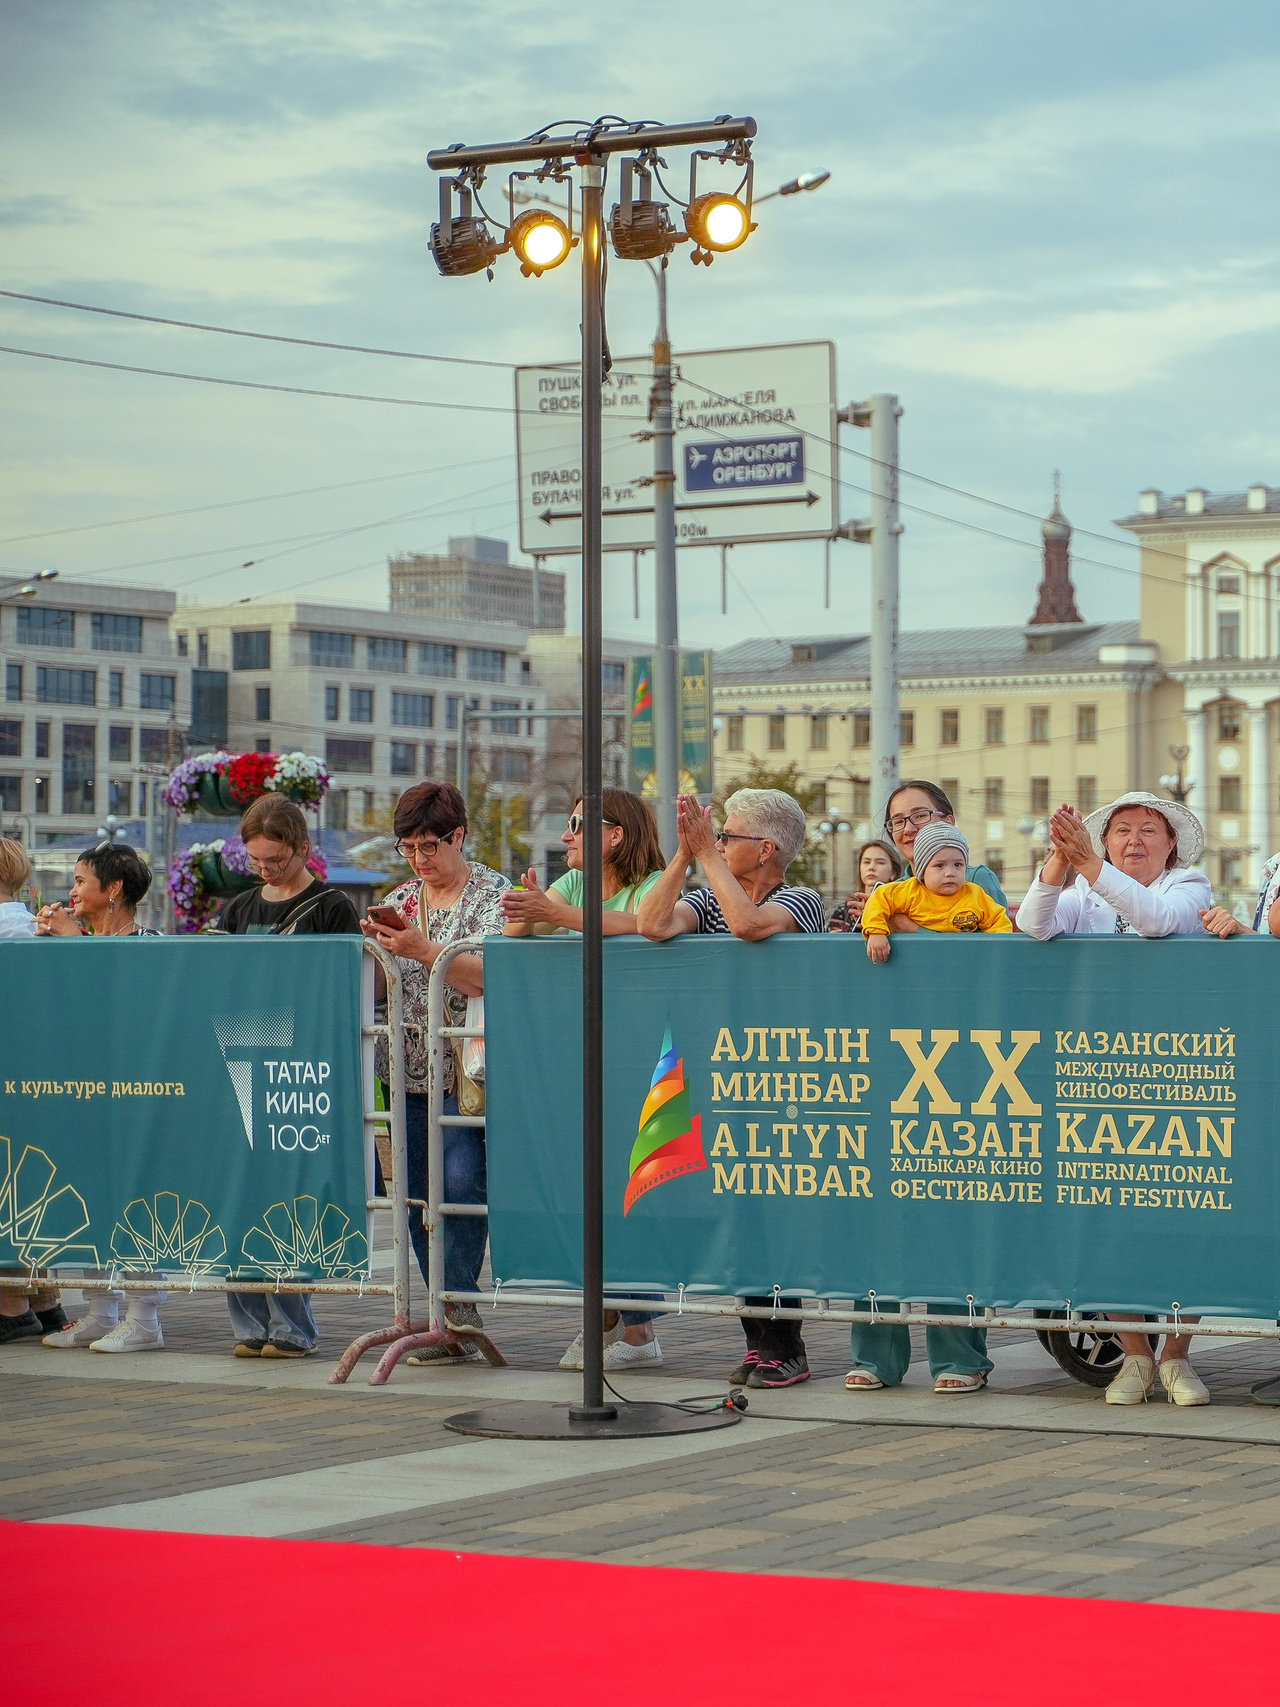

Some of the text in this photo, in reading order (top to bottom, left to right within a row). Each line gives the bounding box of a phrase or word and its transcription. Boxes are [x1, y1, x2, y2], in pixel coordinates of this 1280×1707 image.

[539, 375, 613, 392] ПУШКА
[539, 393, 617, 412] СВОБЫ
[712, 442, 798, 465] АЭРОПОРТ
[712, 462, 792, 484] ОРЕНБУРГ
[532, 486, 610, 505] БУЛАЧЯ
[711, 1028, 869, 1062] АЛТЫН
[1055, 1027, 1236, 1057] КАЗАНСКИЙ
[264, 1061, 330, 1084] ТАТАР
[890, 1029, 1042, 1116] XX
[1055, 1060, 1236, 1081] МЕЖДУНАРОДНЫЙ
[21, 1080, 106, 1099] культуре
[112, 1080, 185, 1098] диалога
[711, 1072, 870, 1103] МИНБАР
[1056, 1081, 1236, 1102] КИНОФЕСТИВАЛЬ
[266, 1092, 330, 1115] КИНО
[710, 1122, 868, 1159] ALTYN
[890, 1120, 1042, 1158] КАЗАН
[1056, 1112, 1236, 1158] KAZAN
[890, 1158, 1042, 1175] ХАЛЫКАРА КИНО
[1056, 1161, 1233, 1184] INTERNATIONAL
[711, 1163, 873, 1198] MINBAR
[890, 1180, 1042, 1203] ФЕСТИВАЛЕ
[1056, 1185, 1232, 1210] FILM FESTIVAL
